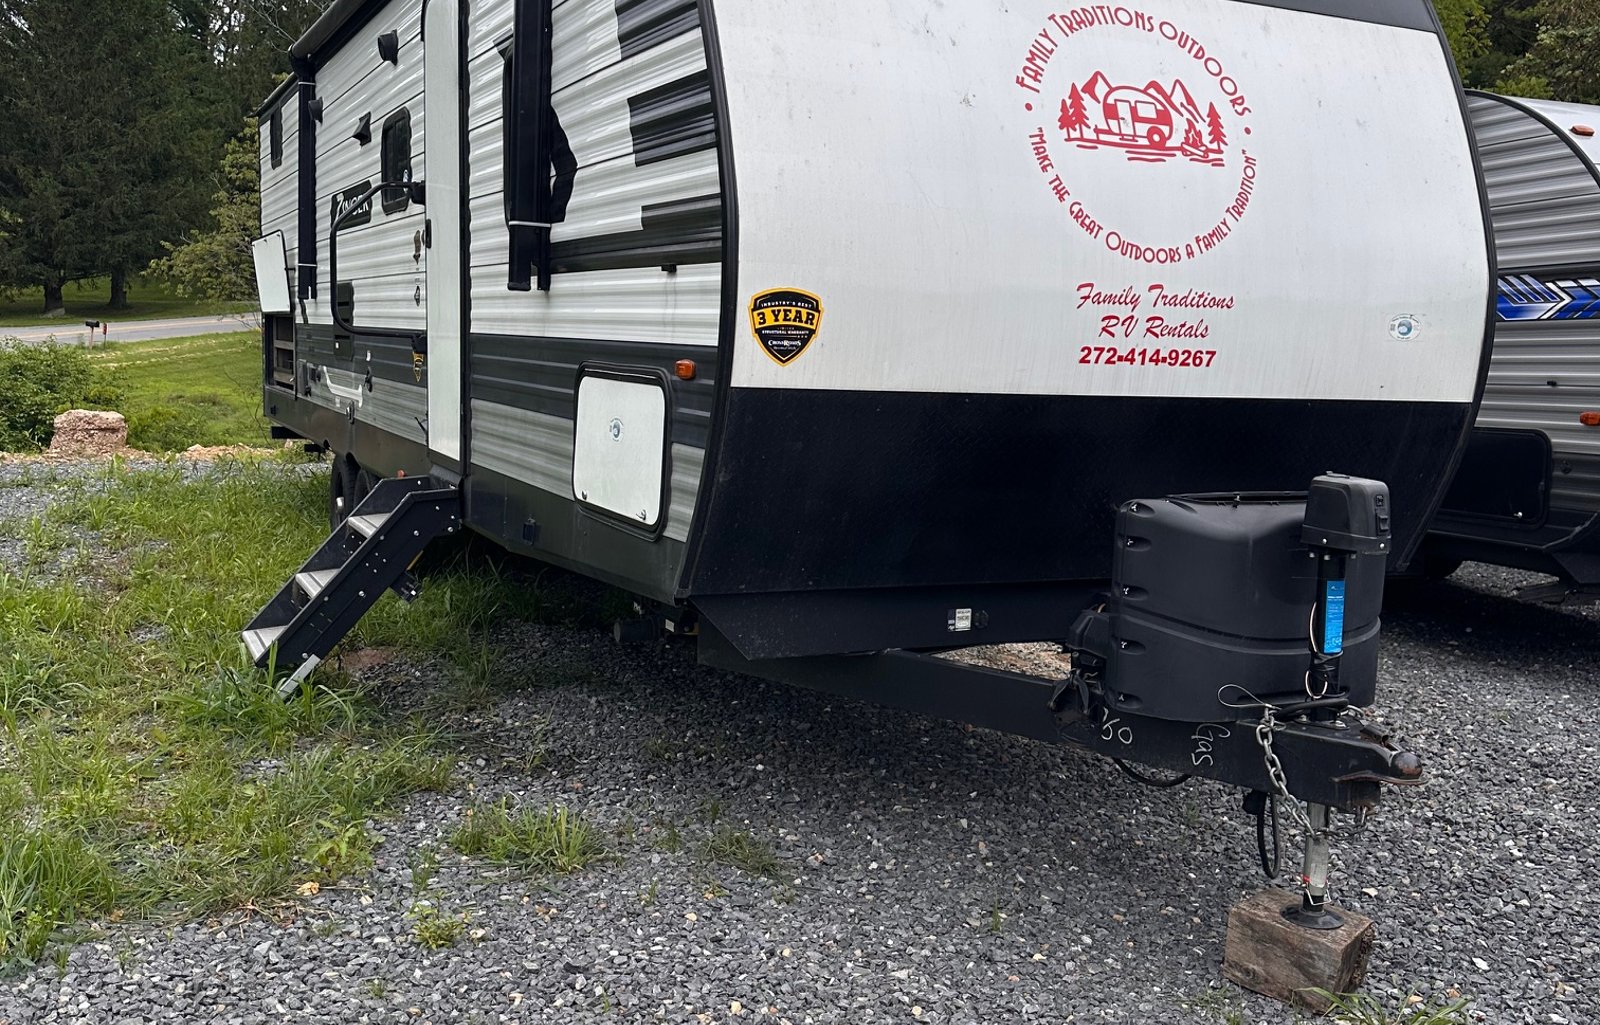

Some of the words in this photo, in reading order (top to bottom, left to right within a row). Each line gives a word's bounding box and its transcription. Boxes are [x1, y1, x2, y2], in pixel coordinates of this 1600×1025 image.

[1016, 28, 1058, 93] FAMILY
[1048, 5, 1154, 37] TRADITIONS
[1159, 21, 1252, 116] OUTDOORS
[1048, 174, 1070, 203] THE
[1069, 201, 1103, 239] GREAT
[1106, 232, 1181, 264] OUTDOORS
[1186, 244, 1195, 259] A
[1195, 218, 1232, 254] FAMILY
[1076, 282, 1141, 312] Family
[1147, 283, 1235, 309] Traditions
[757, 311, 766, 325] 3
[771, 308, 815, 325] YEAR
[1099, 314, 1139, 338] RV
[1143, 315, 1209, 339] Rentals
[1078, 346, 1217, 368] 272-414-9267
